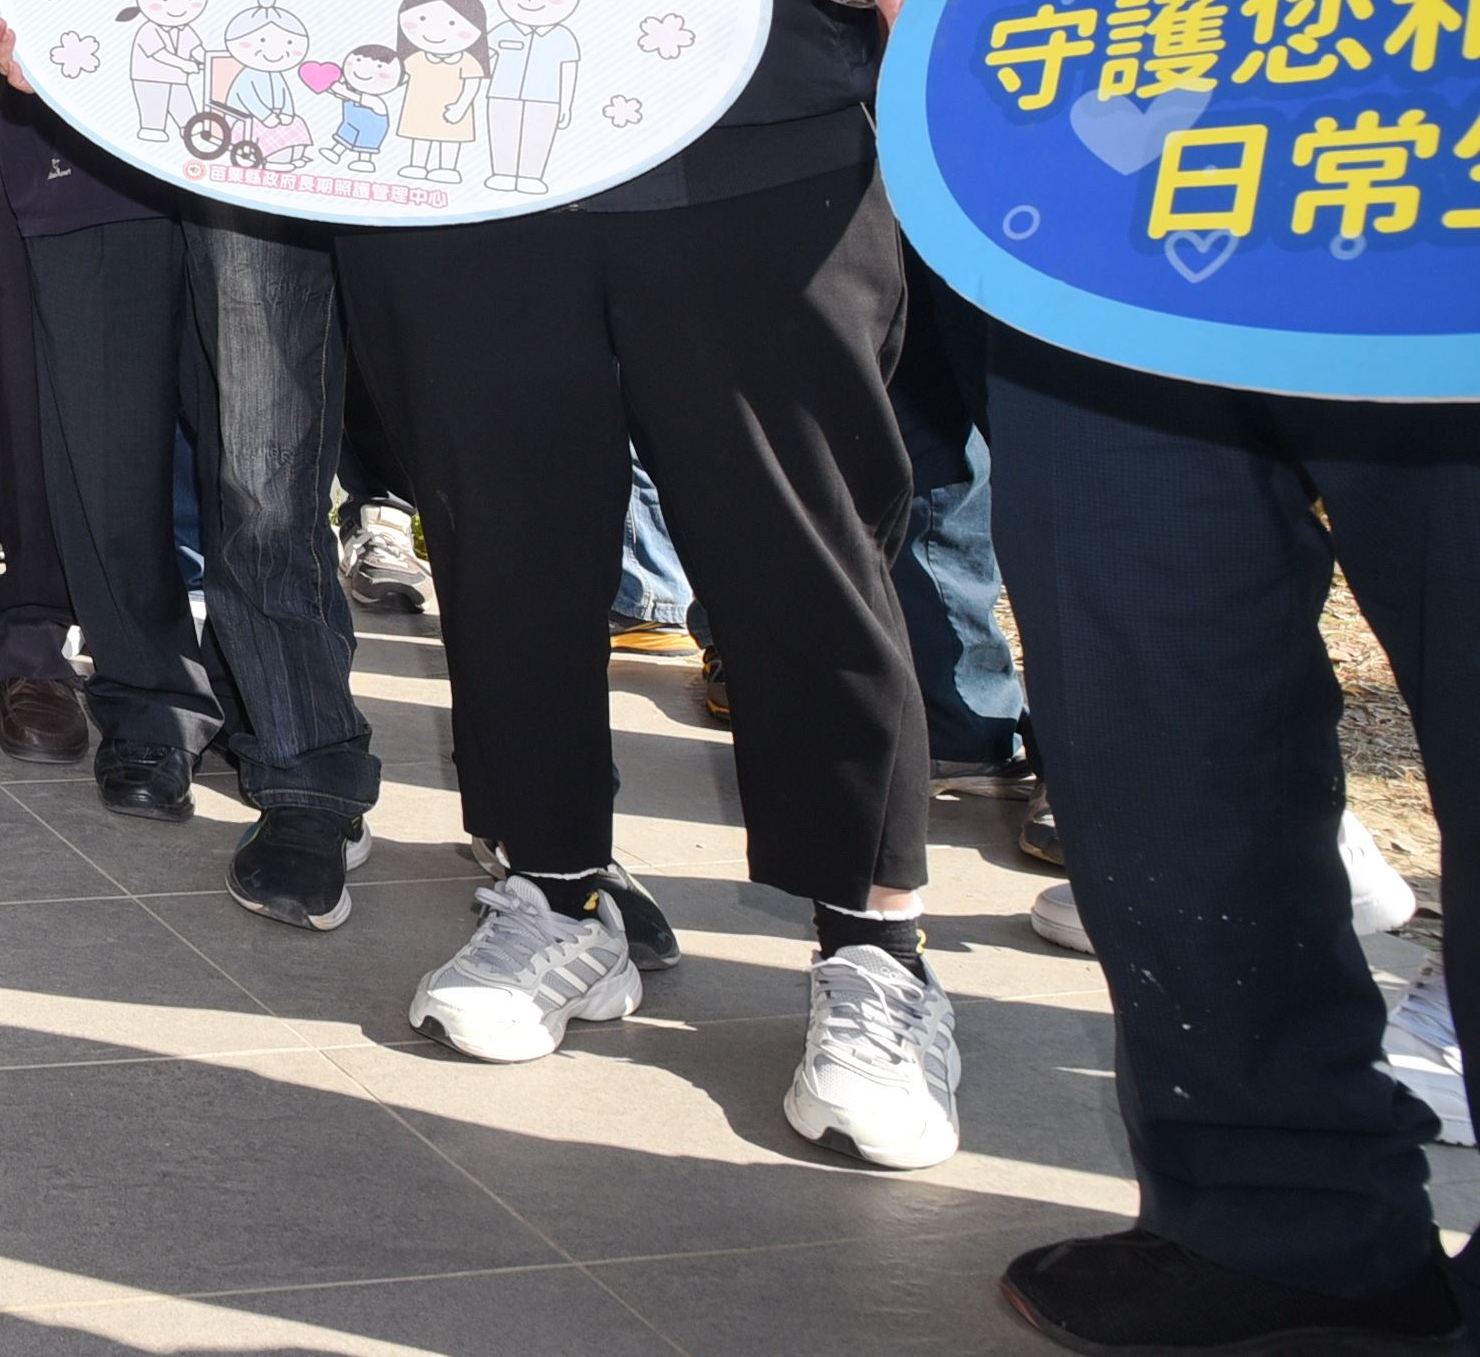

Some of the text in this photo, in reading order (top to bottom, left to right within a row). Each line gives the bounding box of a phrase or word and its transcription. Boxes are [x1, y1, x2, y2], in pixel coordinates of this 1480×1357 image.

[209, 164, 448, 209] 苗栗縣政府長期照護管理中心
